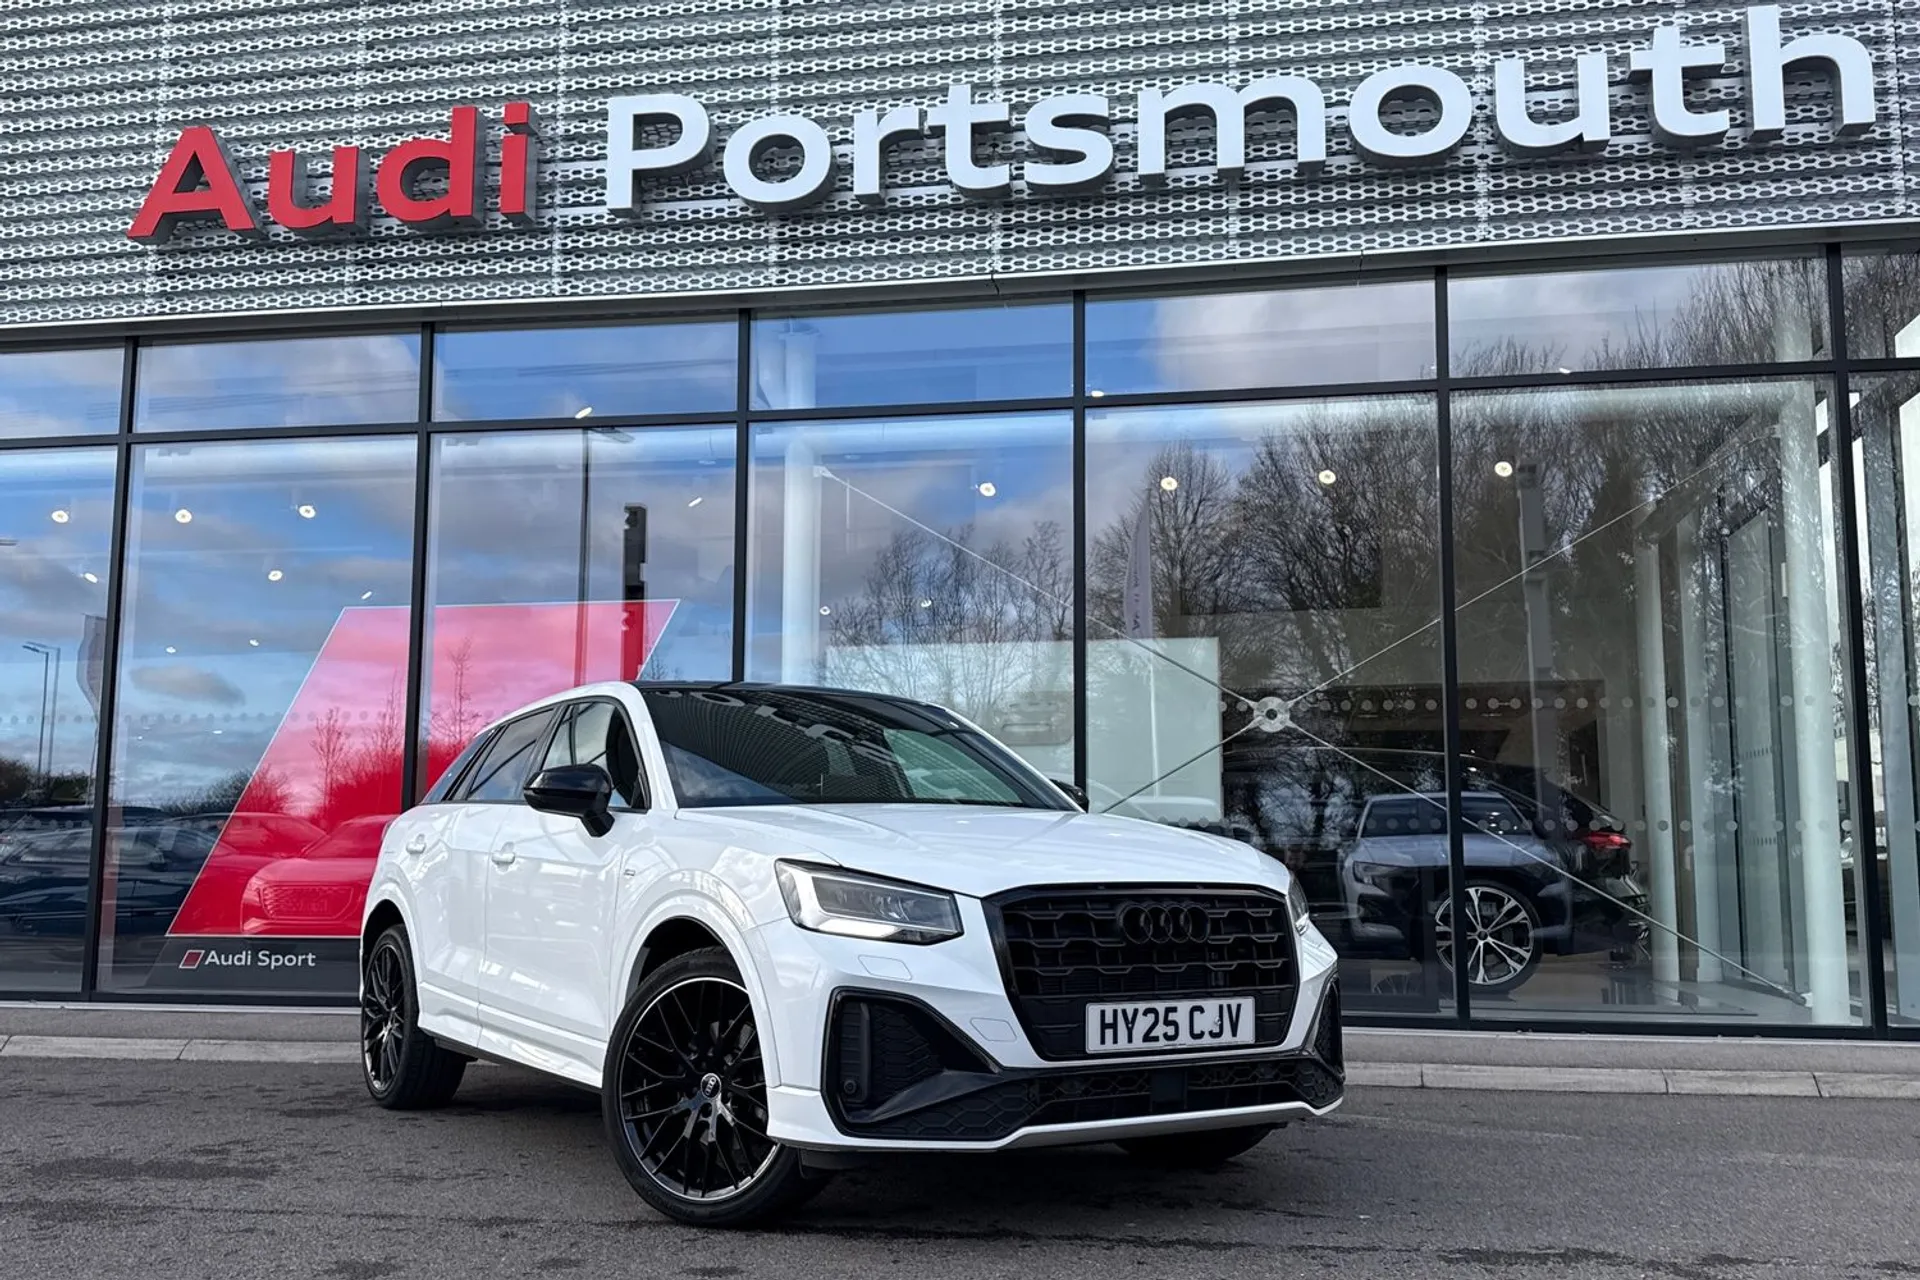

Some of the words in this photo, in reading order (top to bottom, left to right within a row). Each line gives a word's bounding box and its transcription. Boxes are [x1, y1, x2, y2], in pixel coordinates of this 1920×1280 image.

[127, 102, 530, 241] Audi
[605, 6, 1876, 210] Portsmouth
[204, 950, 252, 966] Audi
[257, 950, 316, 970] Sport
[1100, 1006, 1179, 1045] HY25
[1188, 1003, 1242, 1039] CJV
